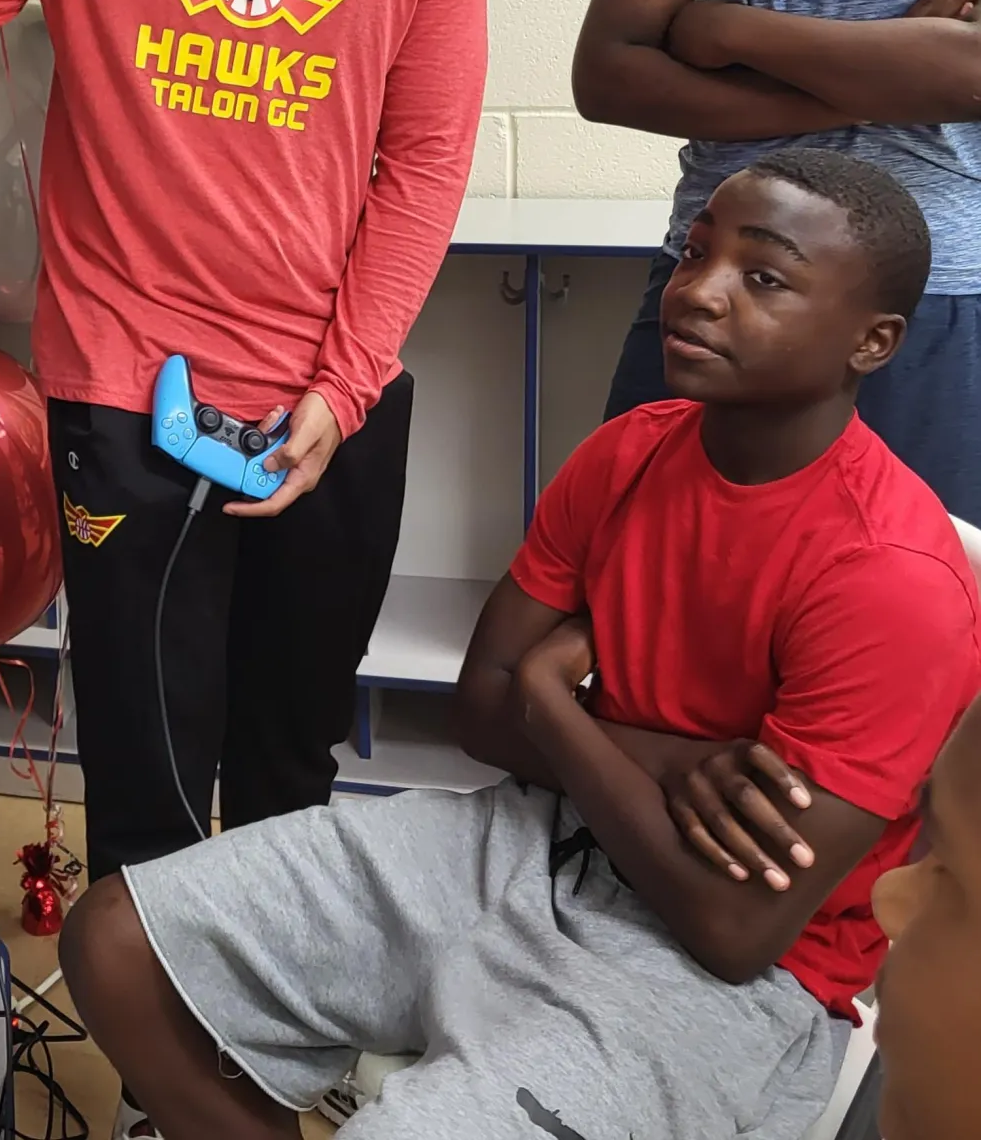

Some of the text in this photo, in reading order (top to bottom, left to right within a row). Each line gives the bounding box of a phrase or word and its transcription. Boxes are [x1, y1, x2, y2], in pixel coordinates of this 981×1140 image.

[135, 23, 337, 100] HAWKS
[150, 77, 309, 131] TALON GC
